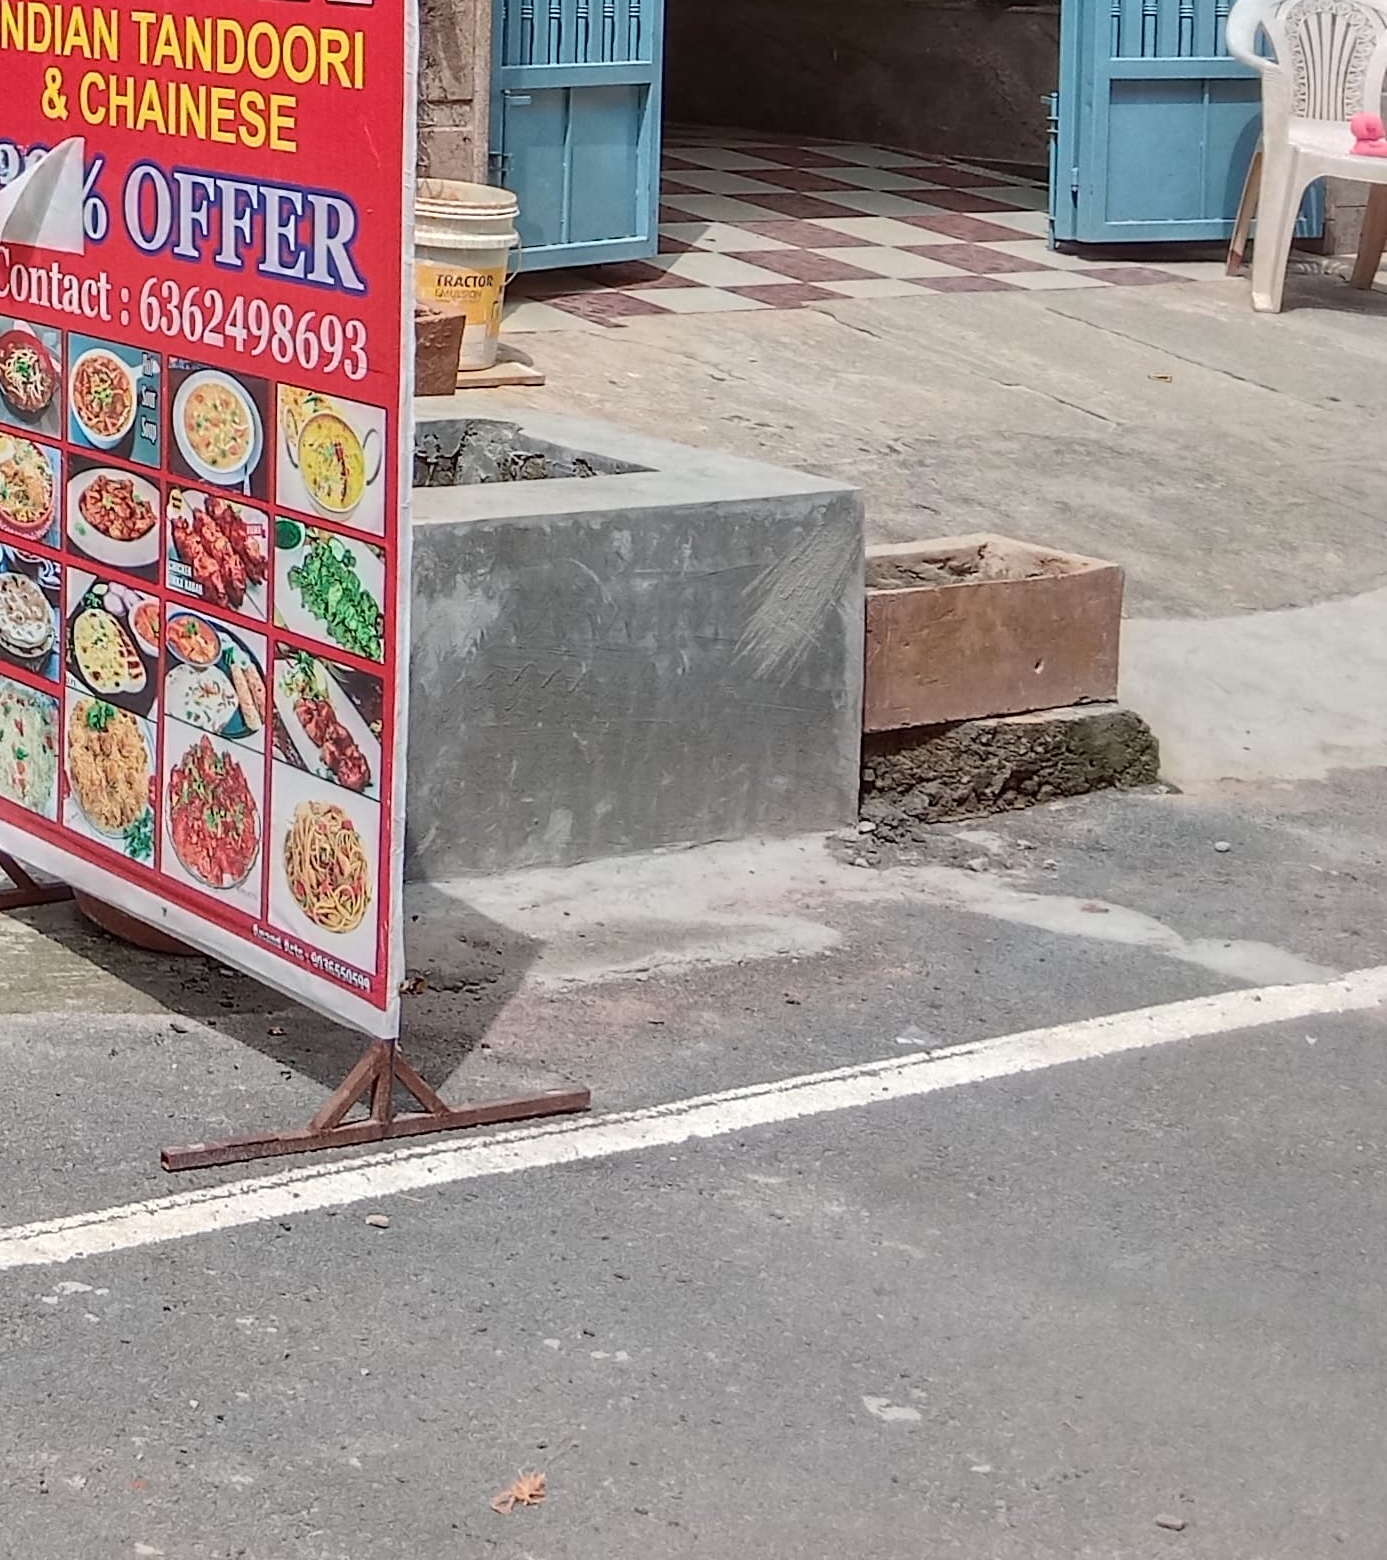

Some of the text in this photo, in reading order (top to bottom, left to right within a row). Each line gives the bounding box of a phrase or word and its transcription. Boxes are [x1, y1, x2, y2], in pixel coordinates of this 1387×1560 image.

[130, 11, 364, 90] TANDOORI
[41, 67, 297, 153] & CHAINESE
[124, 162, 366, 293] OFFER
[435, 273, 495, 289] TRACTOR
[138, 276, 369, 383] 6362498693
